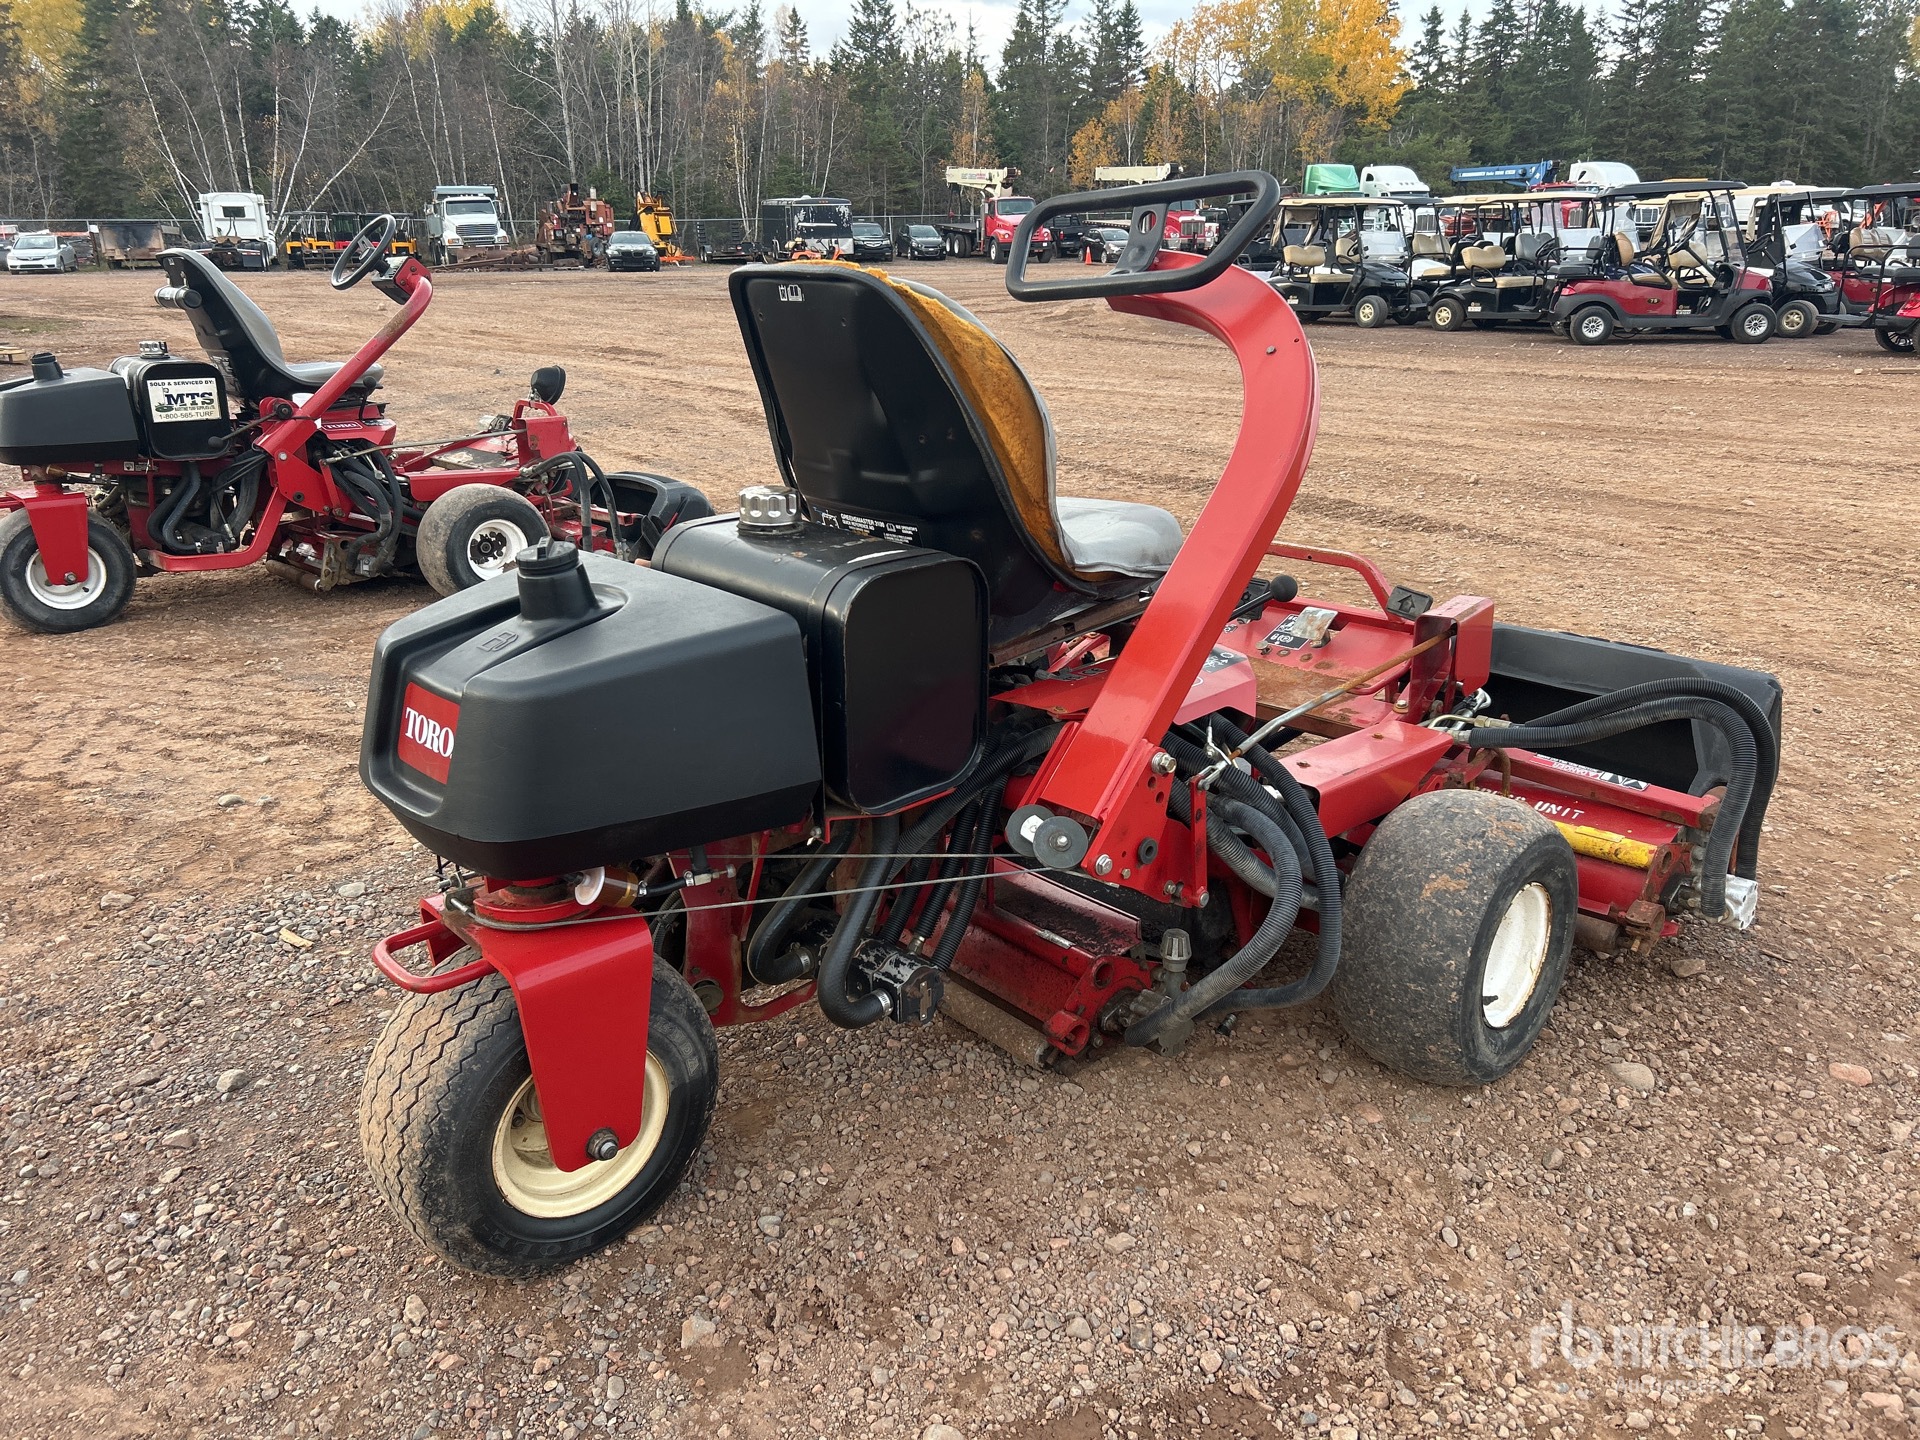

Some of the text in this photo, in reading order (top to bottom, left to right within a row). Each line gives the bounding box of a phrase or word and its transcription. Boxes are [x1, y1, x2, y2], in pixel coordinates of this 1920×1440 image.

[164, 392, 215, 406] MTS
[405, 706, 455, 758] TORO
[1534, 800, 1585, 819] UNIT
